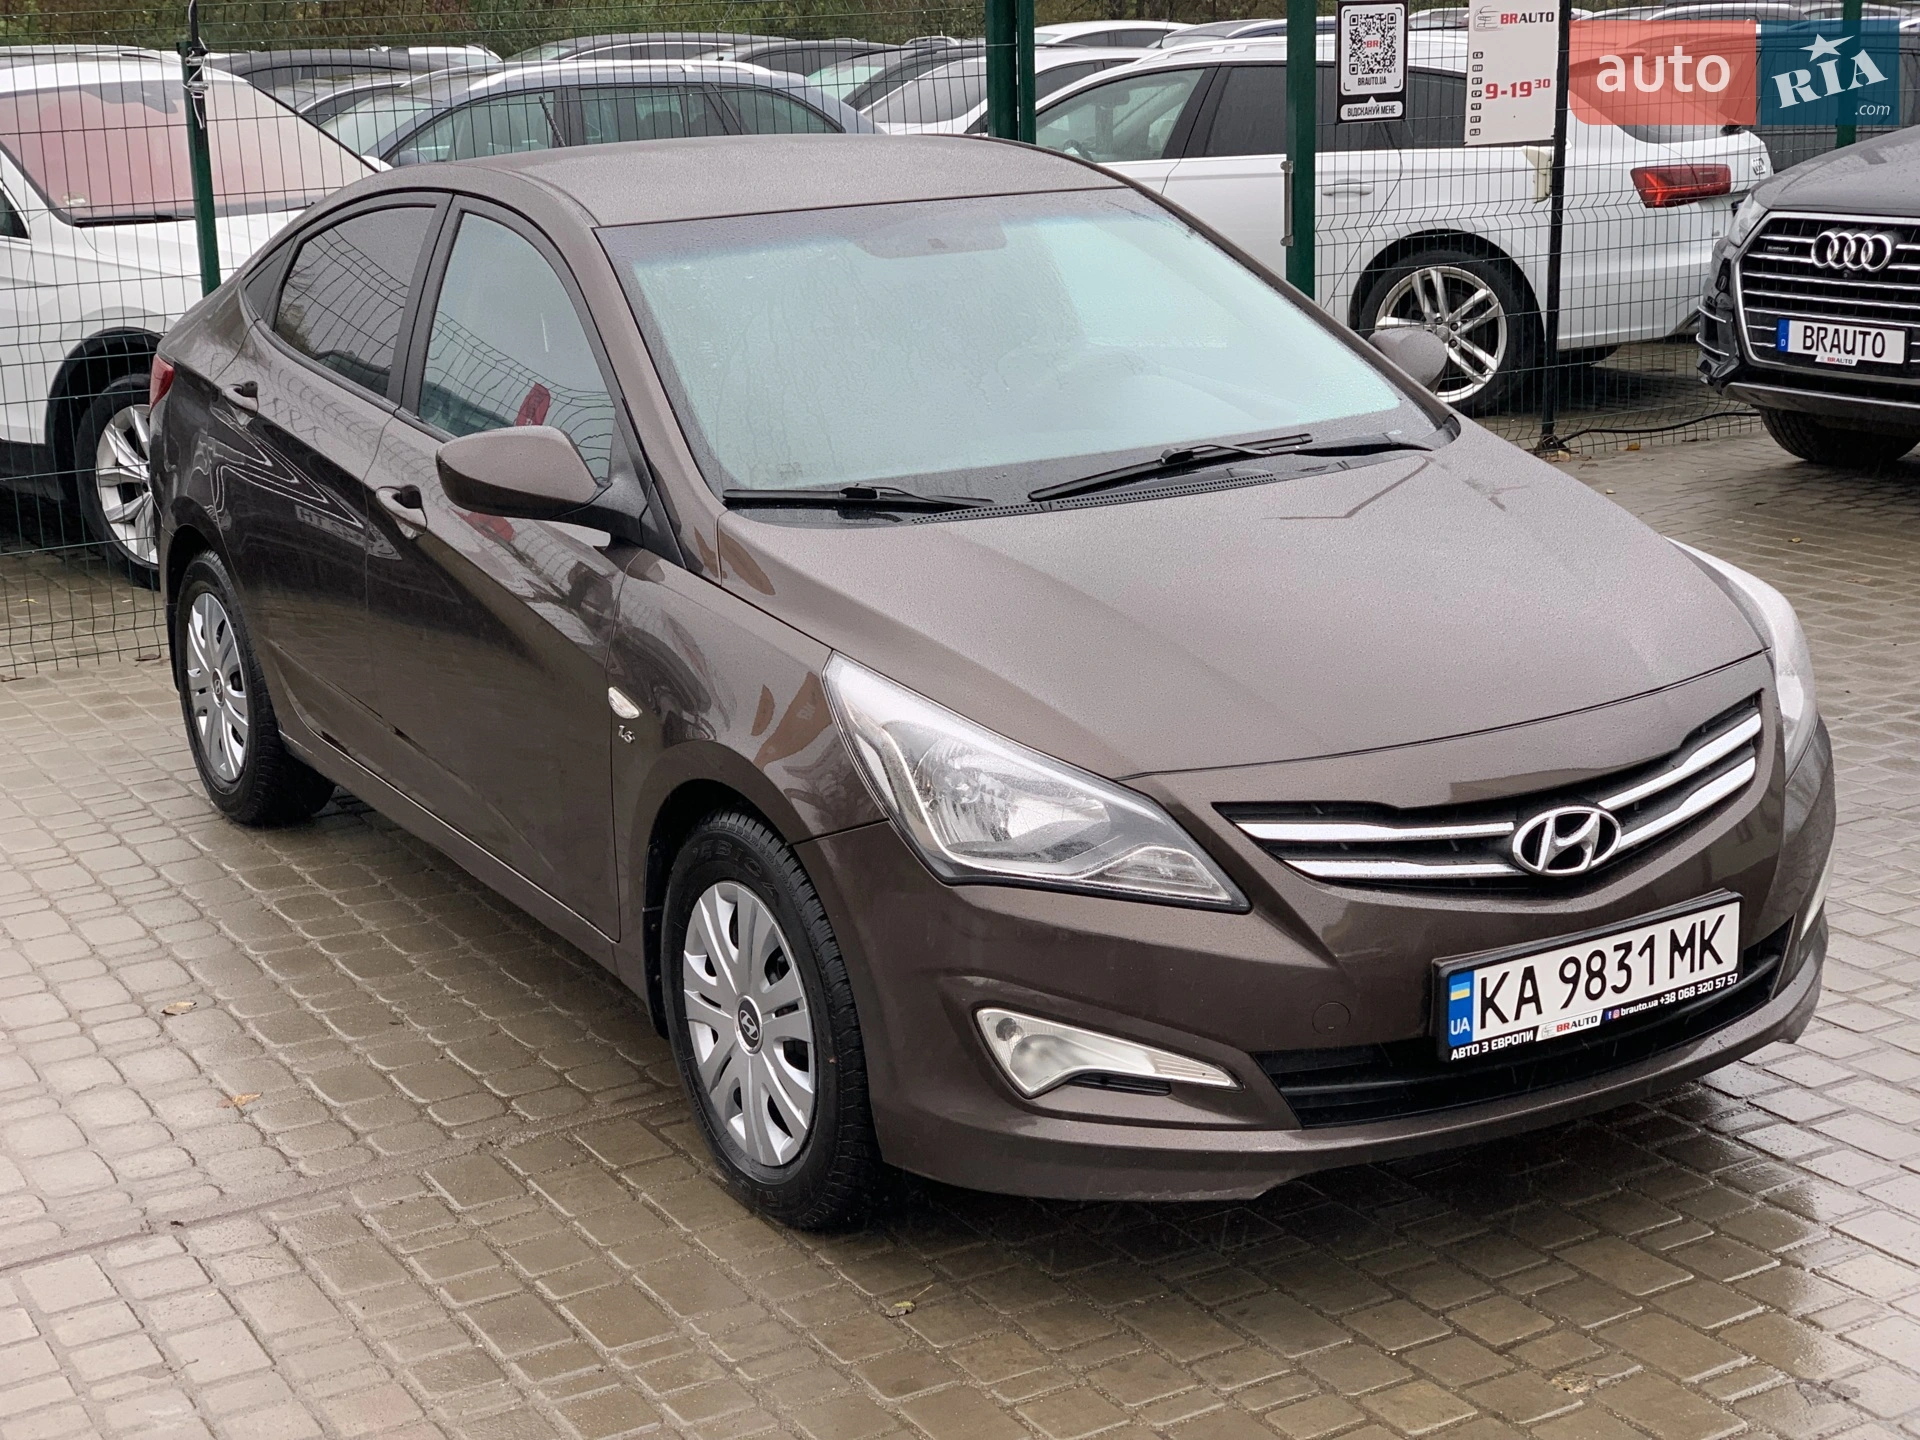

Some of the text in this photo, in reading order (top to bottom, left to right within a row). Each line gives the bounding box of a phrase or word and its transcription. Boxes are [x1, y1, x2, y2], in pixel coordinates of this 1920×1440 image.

[1500, 12, 1554, 24] BRAUTO
[1358, 76, 1387, 86] BRAUTO.UA
[1347, 104, 1396, 117] ВІДСКАНУЙ МЕНЕ
[1780, 338, 1786, 347] D
[1802, 325, 1886, 358] BRAUTO
[1827, 356, 1853, 364] BRAUTO
[1480, 914, 1726, 1030] KA 9831 MK
[1621, 973, 1738, 1016] brauto.ua +38 068 320 57 57
[1450, 1016, 1471, 1036] UA
[1556, 1015, 1598, 1033] BRAUTO
[1451, 1044, 1479, 1061] АВТО
